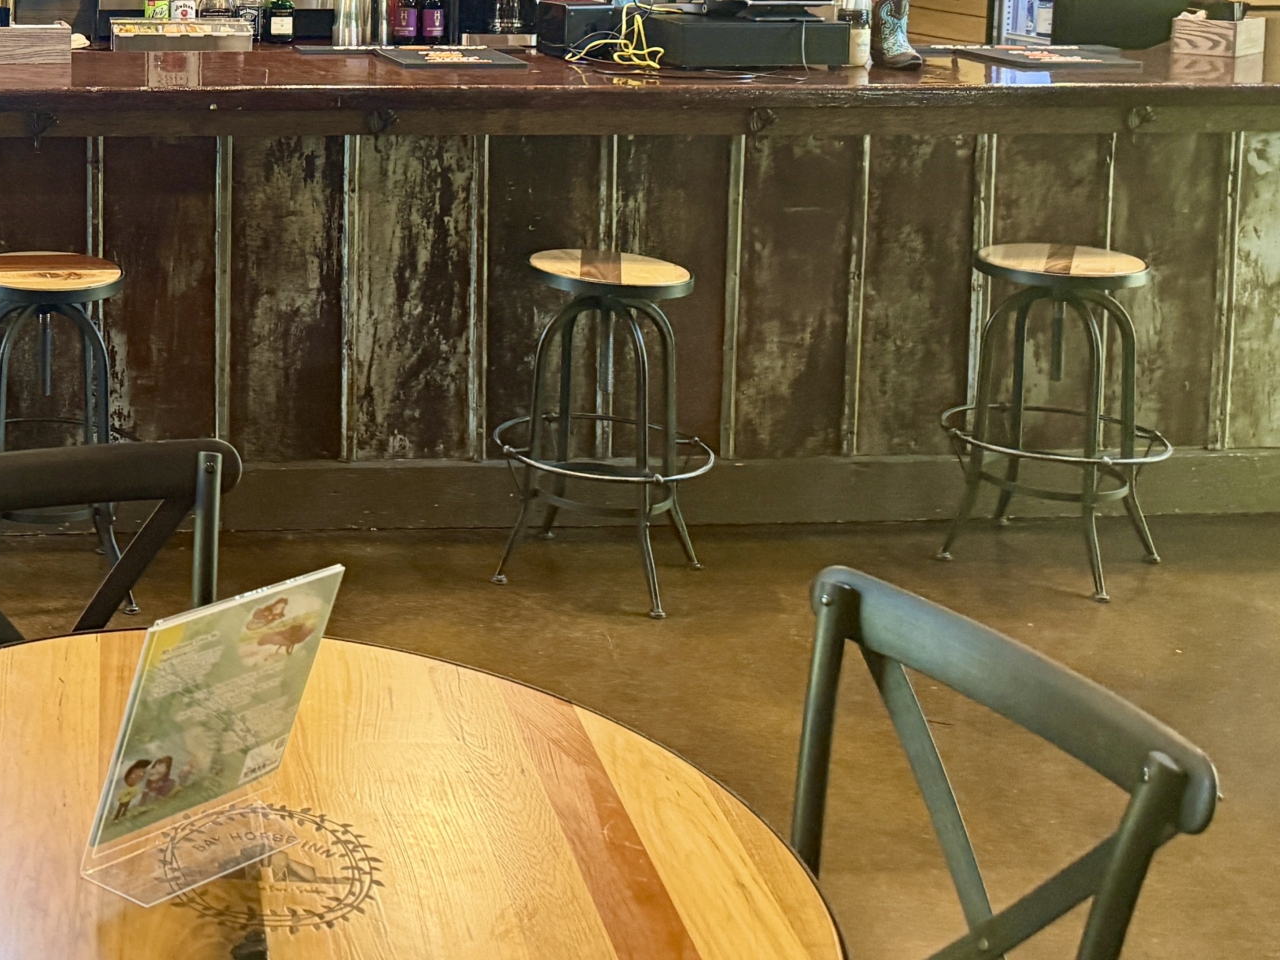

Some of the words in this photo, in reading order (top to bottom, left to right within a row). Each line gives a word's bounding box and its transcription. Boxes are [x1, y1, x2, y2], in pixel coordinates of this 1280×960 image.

[193, 836, 220, 853] BAY
[229, 830, 298, 844] HORSE
[301, 840, 336, 858] INN
